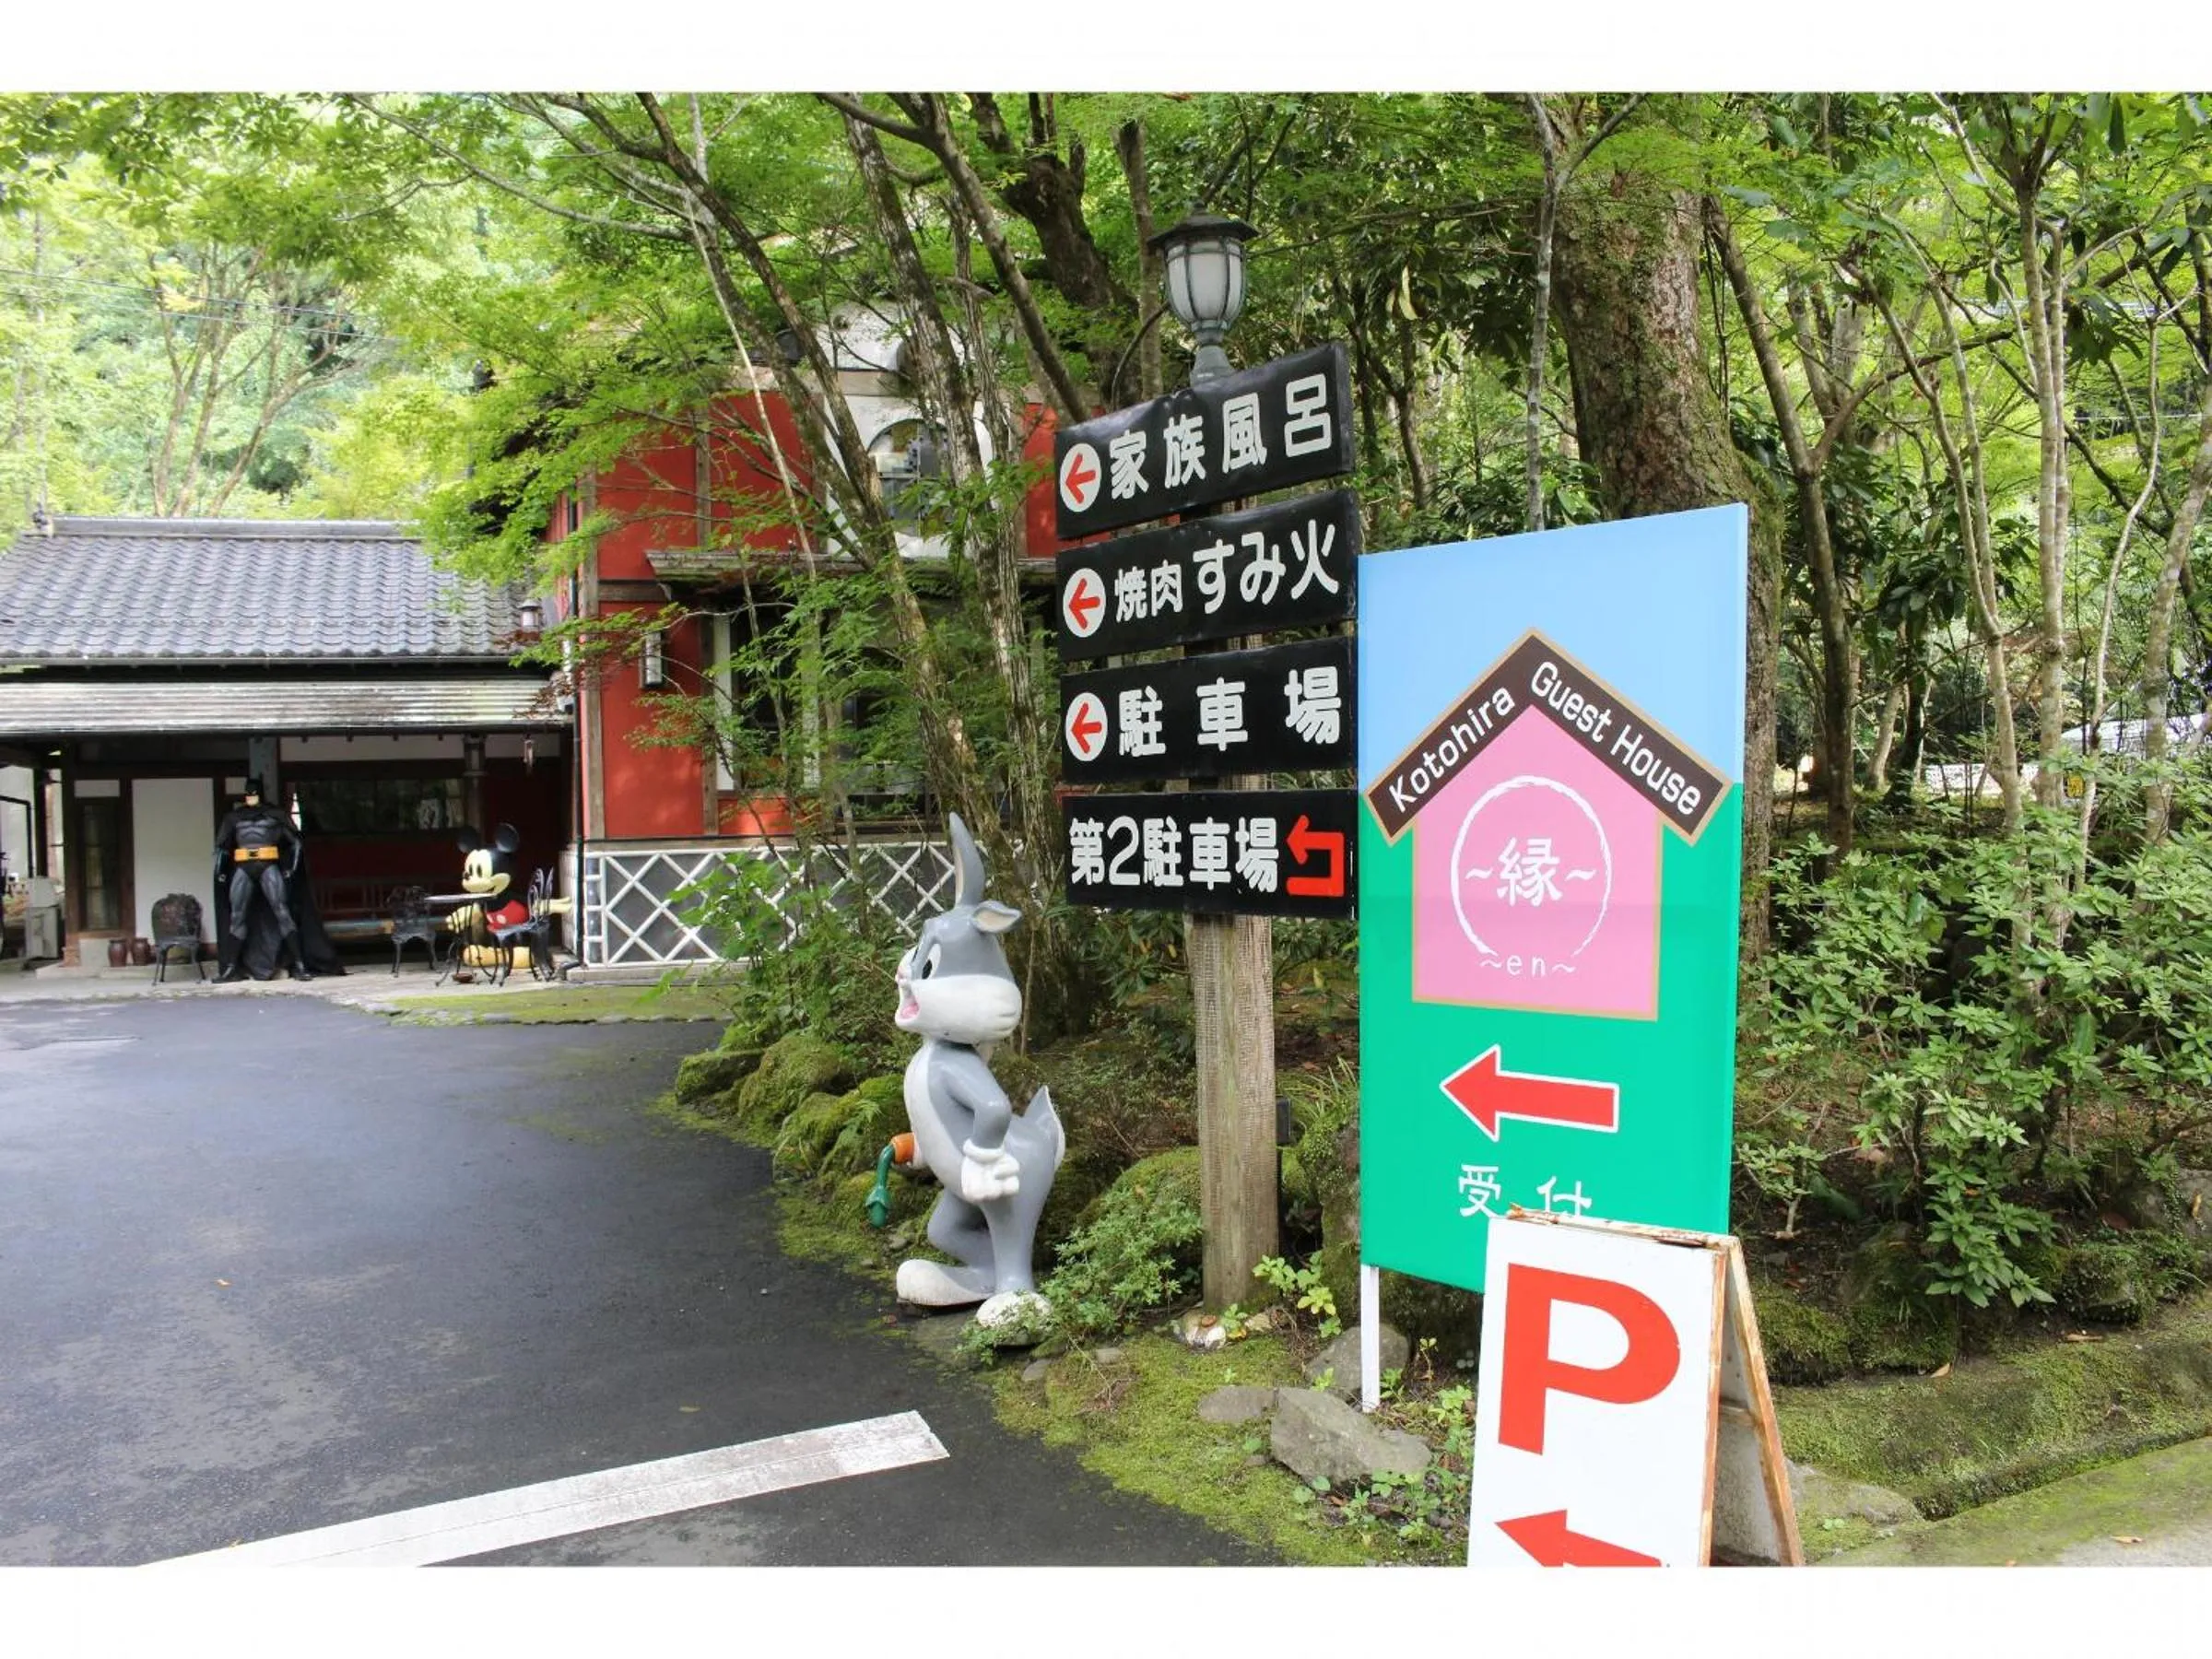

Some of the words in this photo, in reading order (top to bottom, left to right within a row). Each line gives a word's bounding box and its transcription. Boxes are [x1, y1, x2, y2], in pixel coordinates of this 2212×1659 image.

[1109, 373, 1333, 500] 家族風呂
[1118, 665, 1342, 758] 駐車場
[1388, 687, 1516, 813] Kotohira
[1531, 661, 1613, 743] Guest
[1610, 724, 1702, 816] House
[1069, 816, 1280, 894] 第2駐車場
[1499, 1262, 1681, 1455] P
